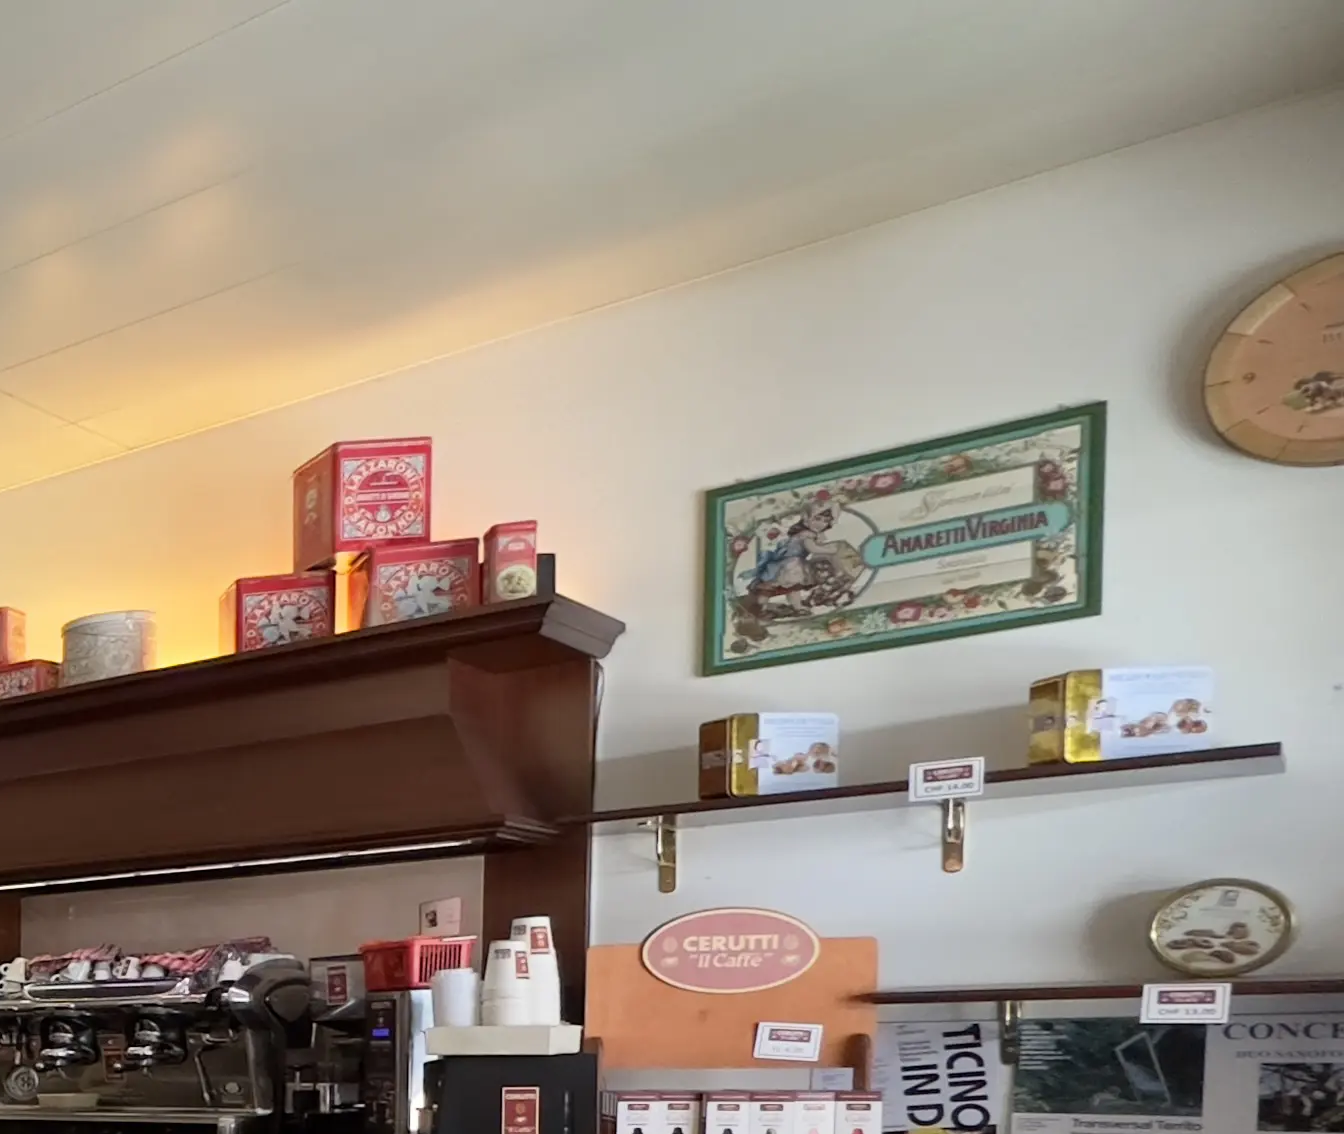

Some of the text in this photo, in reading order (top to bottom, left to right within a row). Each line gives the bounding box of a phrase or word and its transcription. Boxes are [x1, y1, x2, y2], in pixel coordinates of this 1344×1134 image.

[880, 510, 1048, 559] AMARETTI VIRGINIA
[682, 933, 781, 952] CERUTTI
[900, 1063, 941, 1096] IN
[942, 1023, 991, 1132] TICINO
